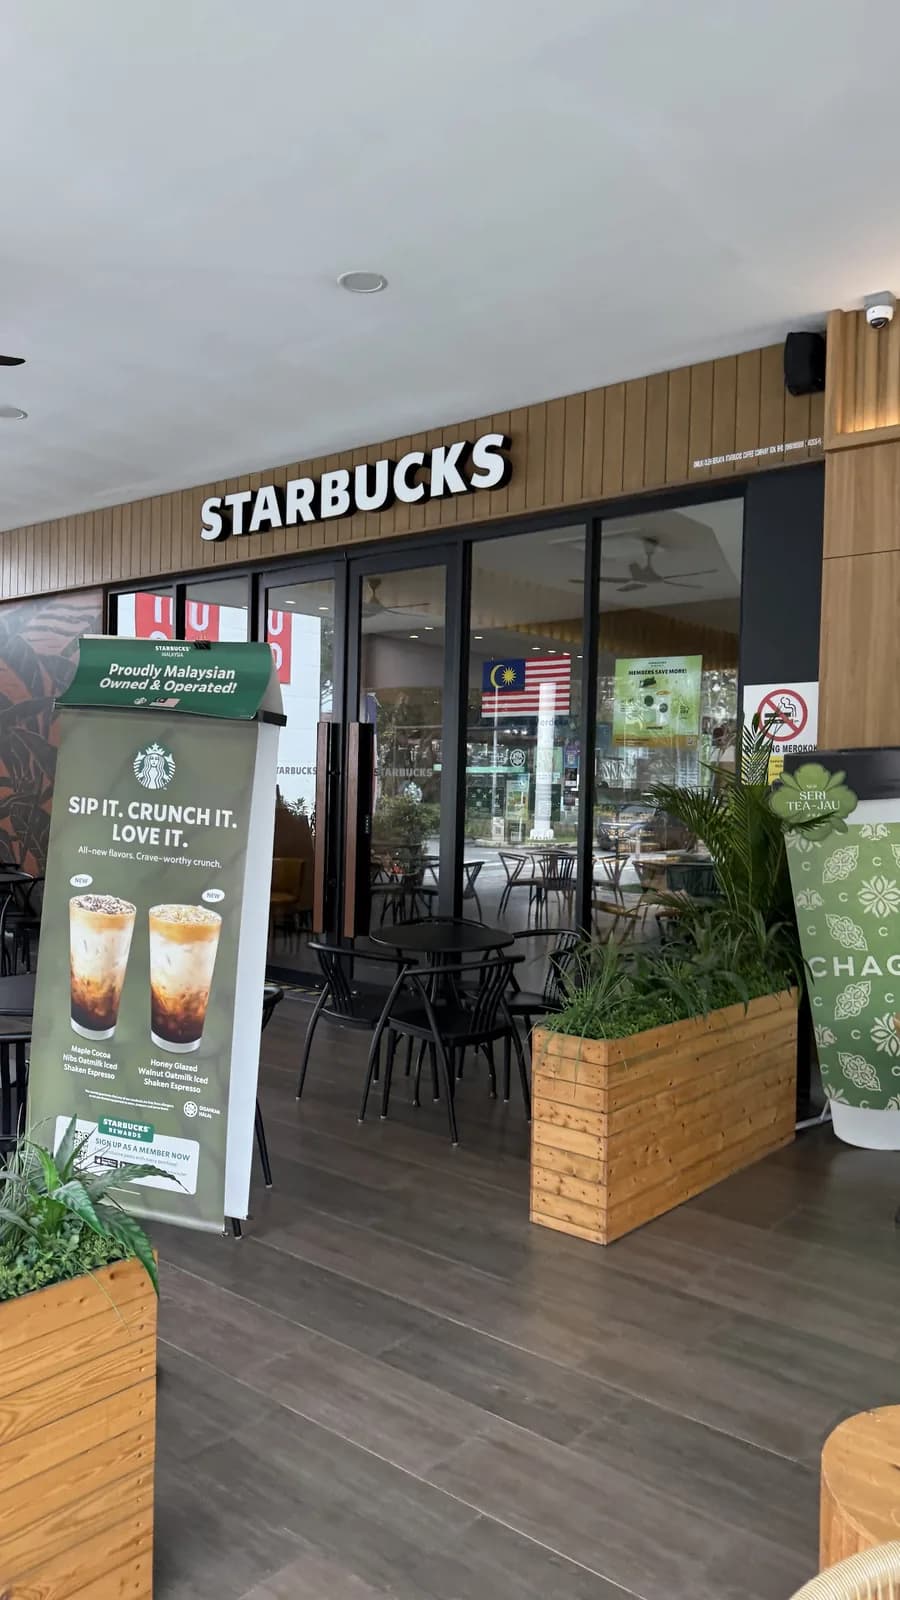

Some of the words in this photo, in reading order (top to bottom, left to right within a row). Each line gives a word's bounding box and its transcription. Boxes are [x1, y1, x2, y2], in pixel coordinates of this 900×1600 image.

[200, 433, 507, 541] STARBUCKS
[109, 663, 162, 678] Proudly
[163, 664, 236, 680] Malaysian
[99, 677, 149, 690] Owned
[150, 680, 161, 691] &
[164, 680, 238, 694] Operated!
[276, 766, 318, 775] TARBUCKS
[799, 791, 826, 800] SERI
[68, 796, 98, 815] SIP
[102, 799, 124, 818] IT.
[127, 801, 210, 826] CRUNCH
[215, 809, 238, 829] IT.
[787, 800, 840, 811] TEA-JAU
[112, 823, 160, 846] LOVE
[164, 829, 189, 848] IT.
[78, 846, 107, 856] All-new
[108, 849, 134, 859] flavors.
[136, 851, 192, 866] Crave-worthy
[193, 859, 222, 869] crunch.
[808, 954, 900, 978] CHAG
[71, 1045, 91, 1055] Maple
[92, 1049, 111, 1059] Cocoa
[63, 1063, 87, 1074] Shaken
[88, 1068, 115, 1080] Espresso
[79, 1056, 103, 1067] Oatmilk
[103, 1061, 118, 1070] Iced
[150, 1059, 173, 1070] Honey
[174, 1062, 198, 1072] Glazed
[138, 1067, 164, 1078] Walnut
[164, 1071, 193, 1082] Oatmilk
[193, 1075, 208, 1085] Iced
[143, 1078, 170, 1088] Shaken
[170, 1082, 201, 1094] Espresso
[103, 1118, 149, 1133] STARBUCKS
[108, 1127, 142, 1139] REWARDS
[95, 1138, 112, 1147] SIGN
[112, 1141, 121, 1149] UP
[122, 1143, 132, 1151] AS
[139, 1147, 170, 1159] MEMBER
[171, 1152, 191, 1161] NOW
